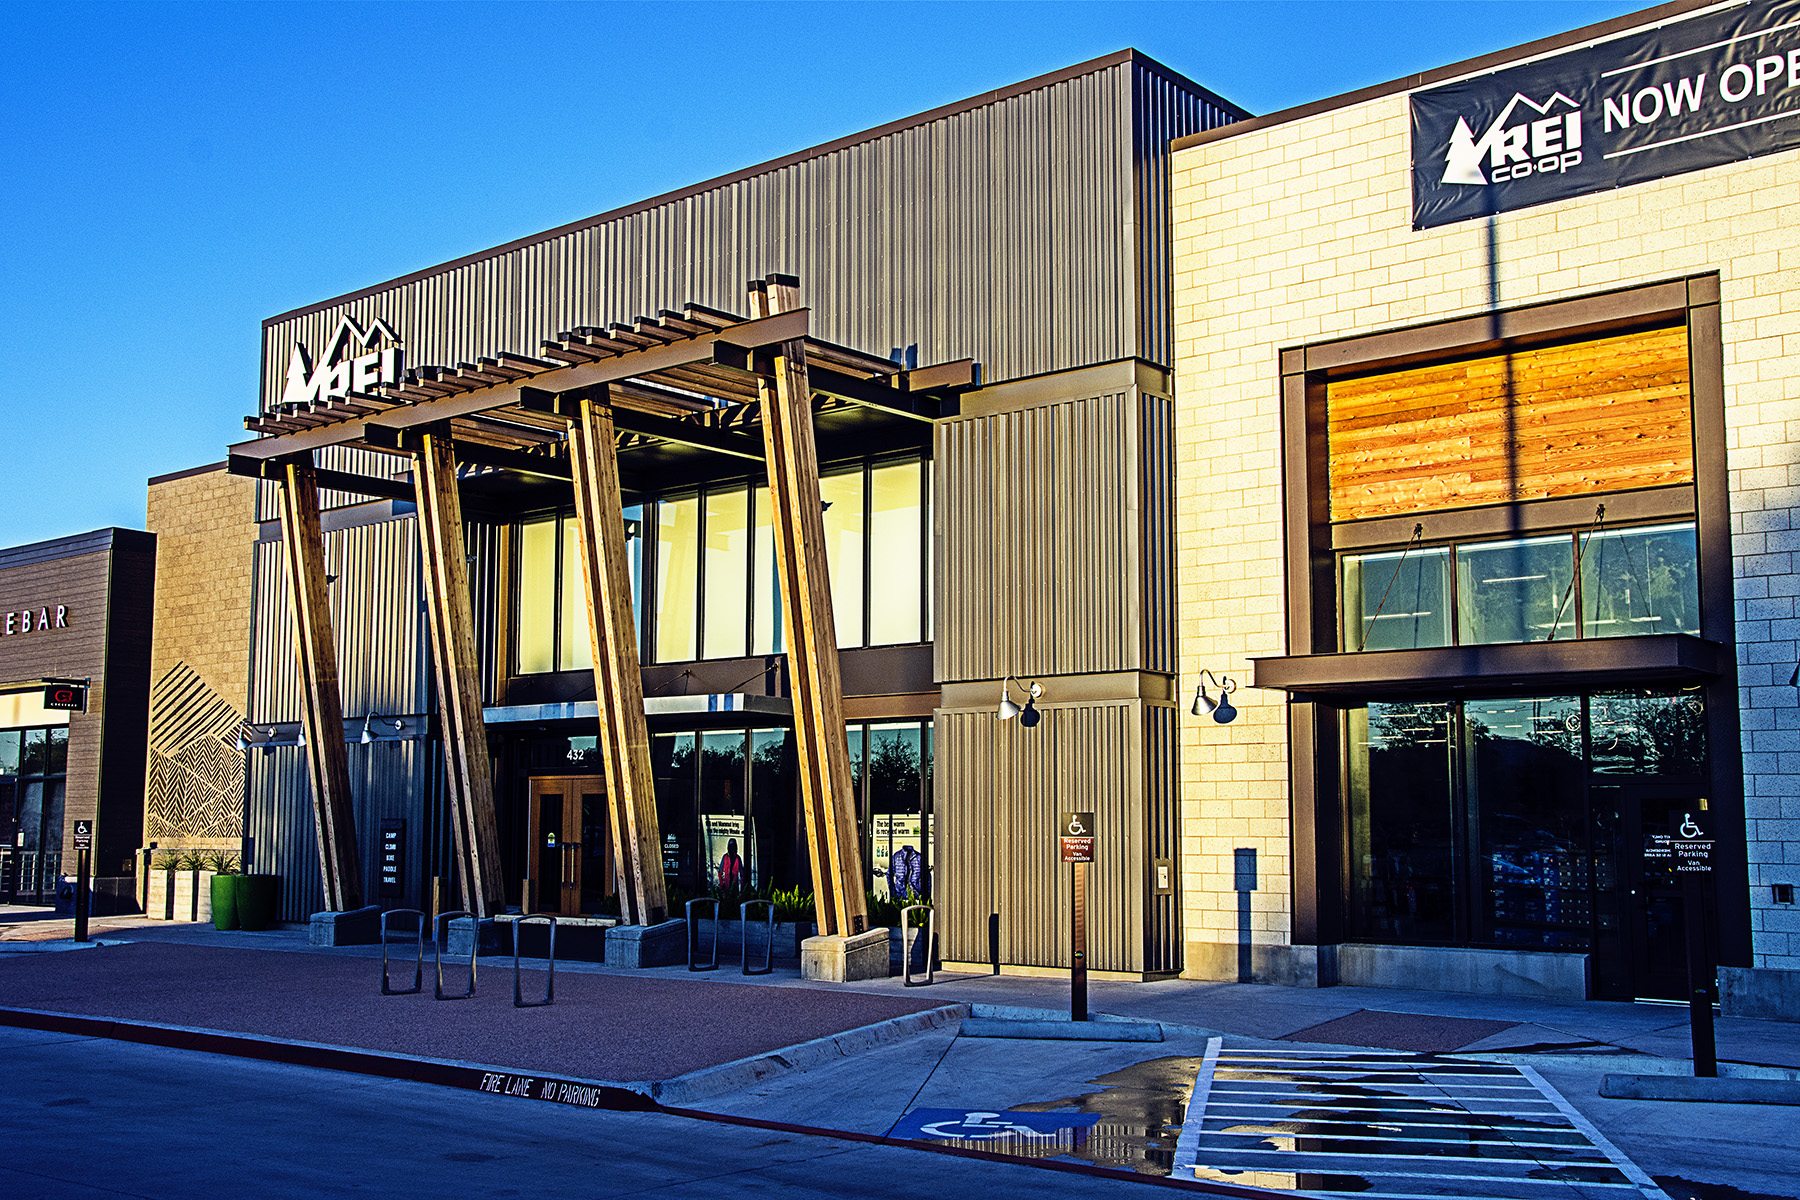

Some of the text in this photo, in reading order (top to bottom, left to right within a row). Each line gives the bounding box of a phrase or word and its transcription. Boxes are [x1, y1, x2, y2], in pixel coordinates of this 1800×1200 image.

[1603, 73, 1707, 133] NOW
[1490, 110, 1582, 168] REI
[566, 749, 585, 761] 432
[876, 820, 884, 828] The
[1678, 850, 1709, 859] Parking
[480, 1073, 601, 1107] FIRE LANE NO PARKING
